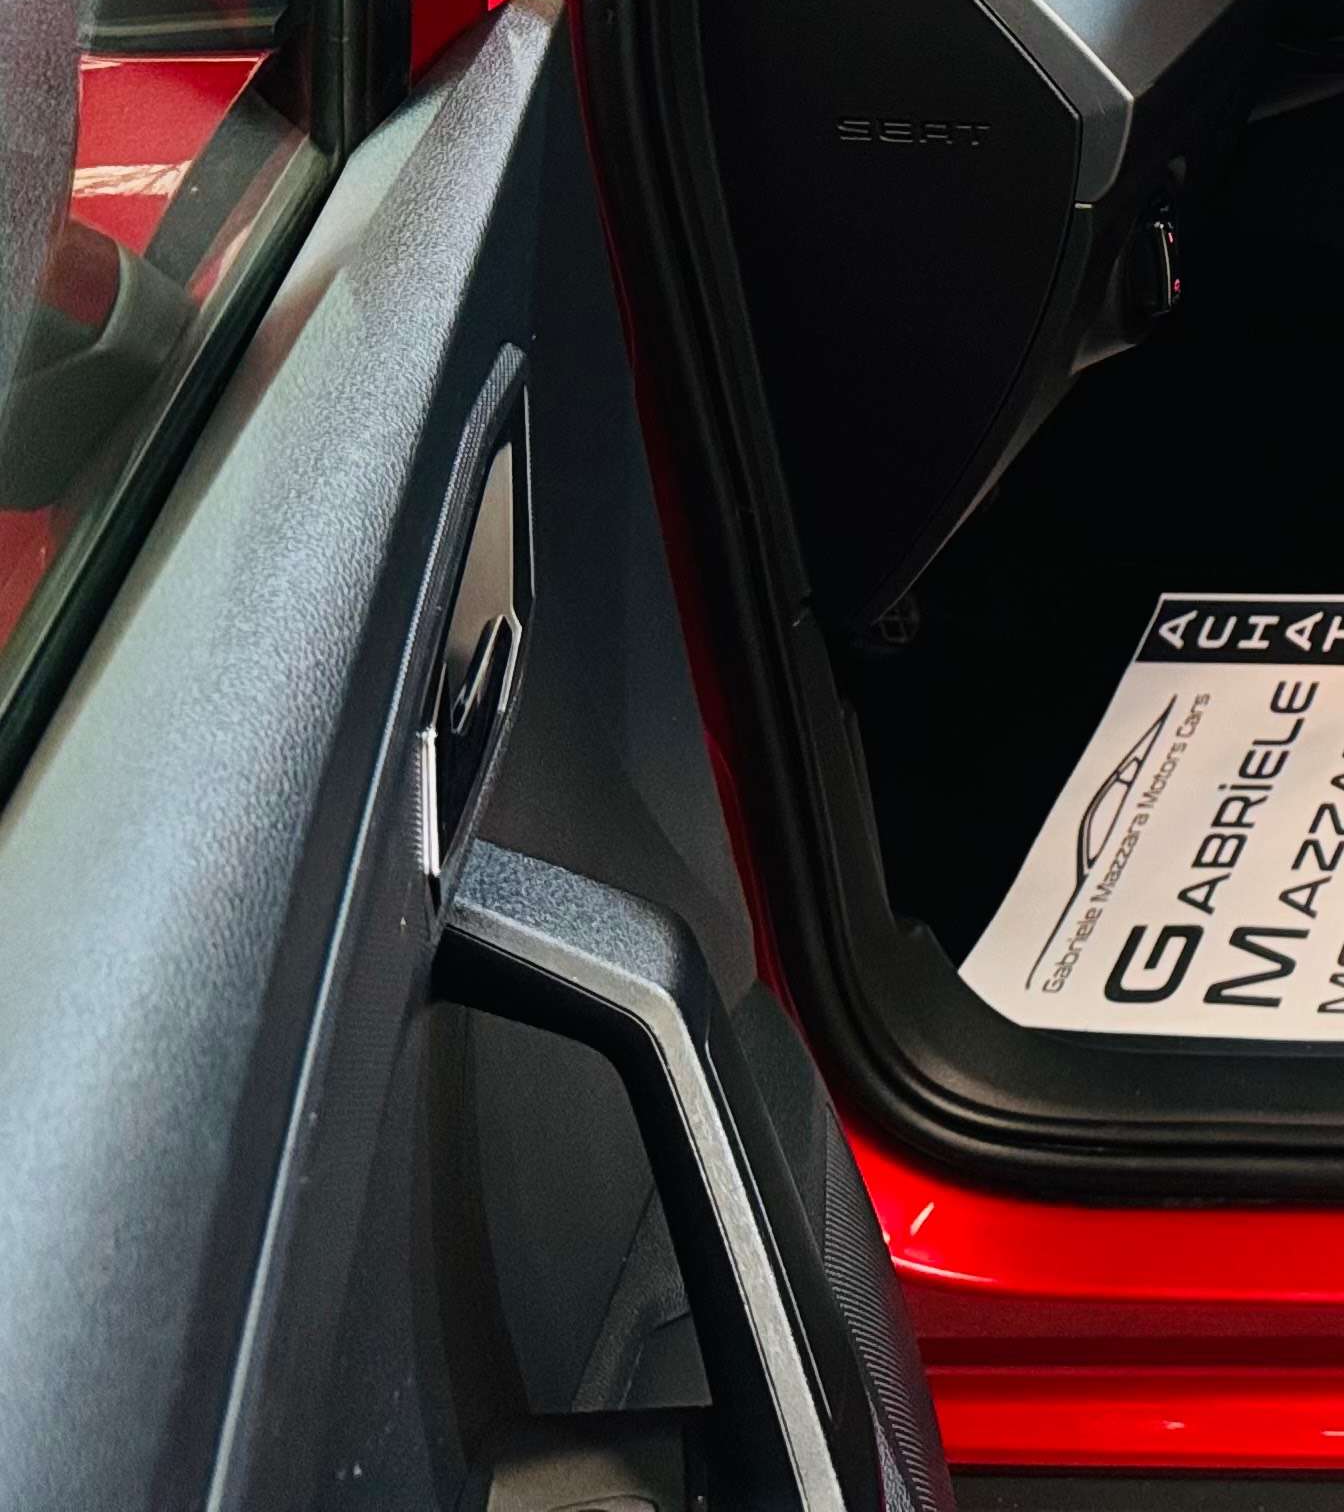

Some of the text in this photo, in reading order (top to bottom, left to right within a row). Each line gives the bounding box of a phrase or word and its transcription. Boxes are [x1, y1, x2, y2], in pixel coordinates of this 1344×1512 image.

[837, 118, 992, 147] SEAT
[1041, 692, 1211, 994] Gabriele Mazzara Motors Cars
